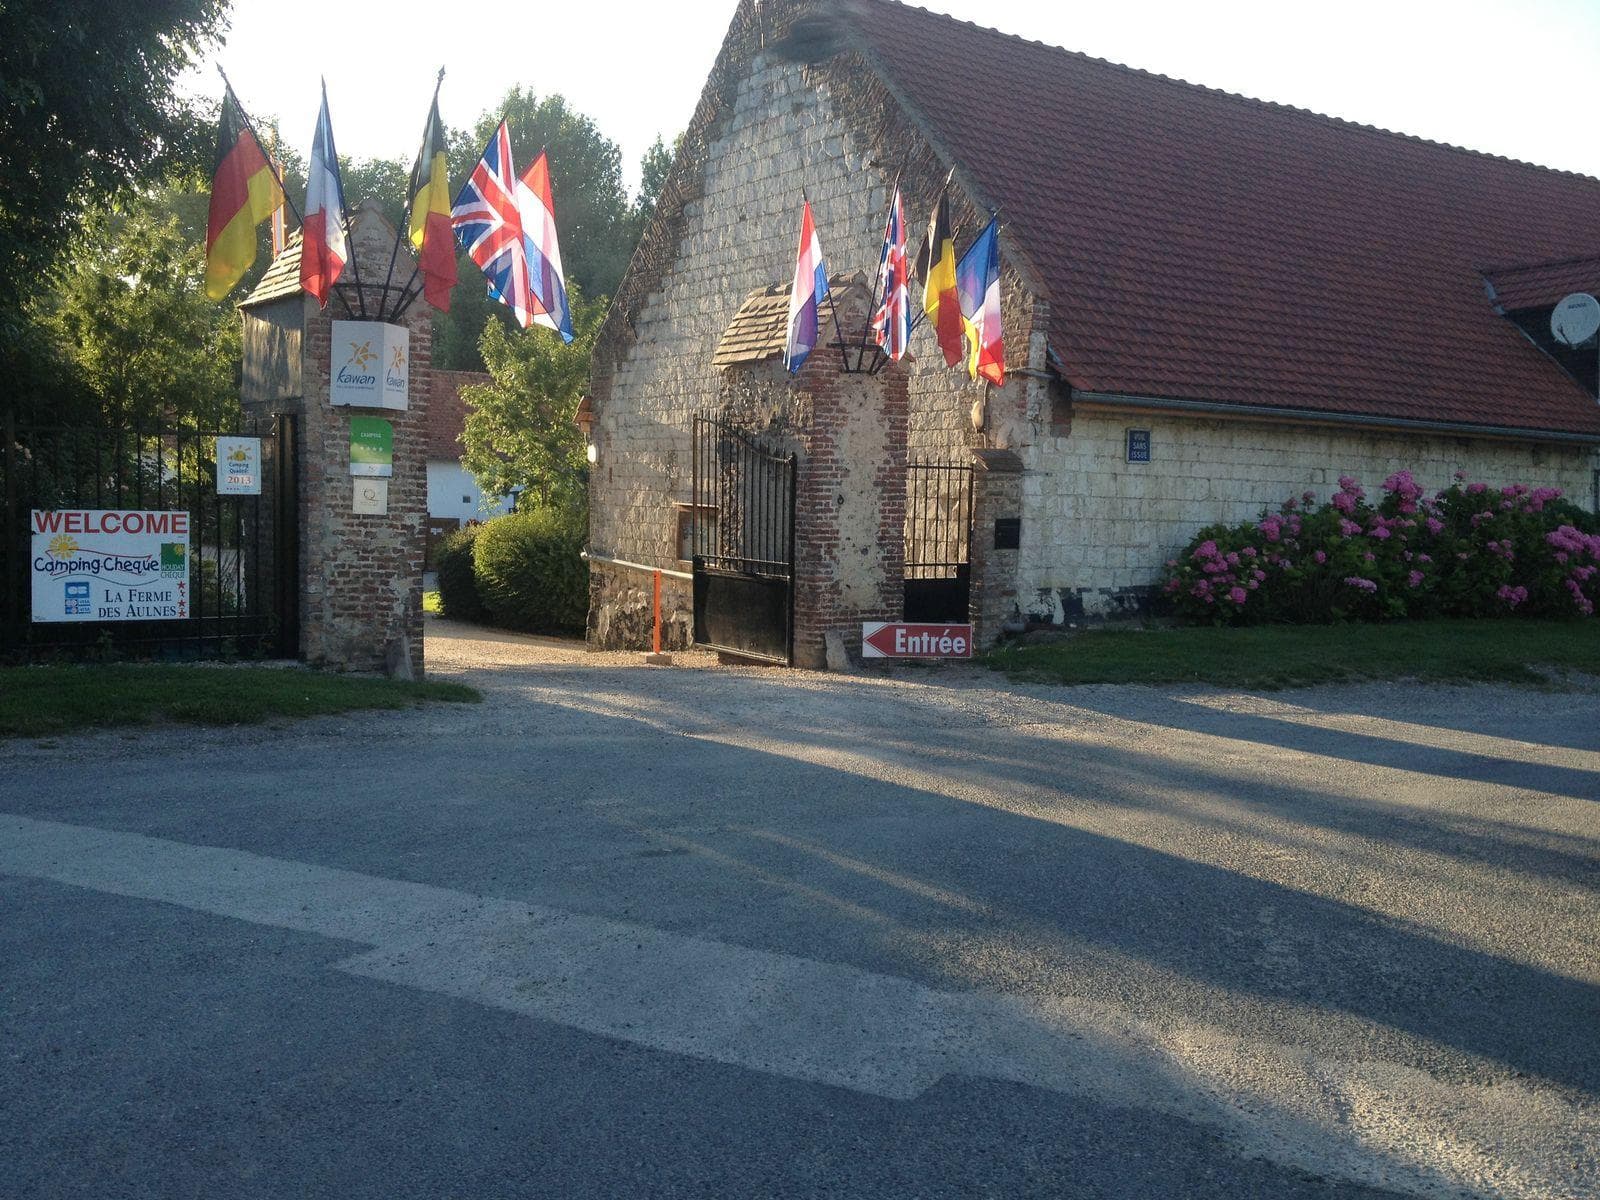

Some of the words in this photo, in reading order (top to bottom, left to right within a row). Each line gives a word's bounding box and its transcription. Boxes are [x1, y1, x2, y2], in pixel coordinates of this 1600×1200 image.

[337, 365, 376, 385] kawan
[227, 475, 252, 485] 2013
[34, 512, 188, 534] WELCOME
[34, 556, 100, 574] Camping
[103, 556, 160, 575] Cheque
[161, 563, 185, 571] HOLIDAY
[128, 589, 172, 603] FERME
[98, 607, 121, 618] DES
[125, 604, 177, 618] AULNES
[895, 628, 966, 654] Entrée
